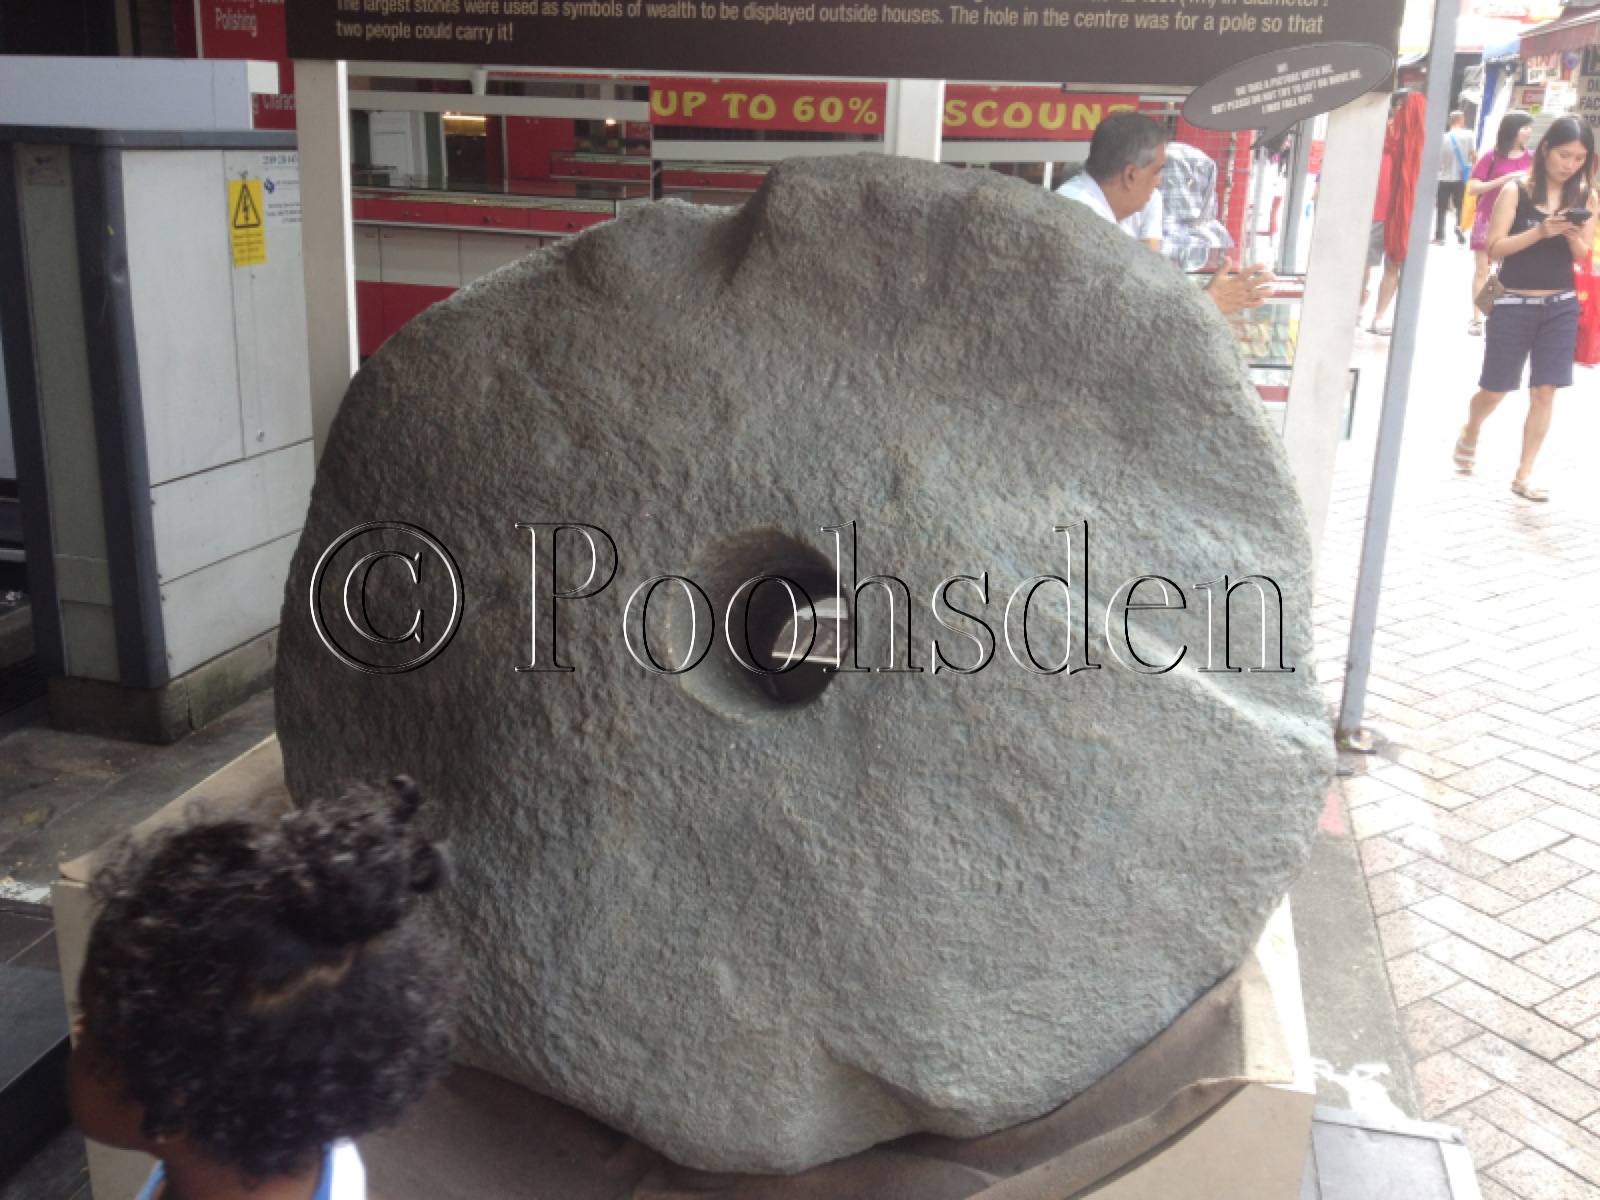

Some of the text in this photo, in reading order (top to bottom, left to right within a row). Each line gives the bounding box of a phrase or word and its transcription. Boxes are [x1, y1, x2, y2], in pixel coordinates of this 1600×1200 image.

[215, 8, 257, 37] Polishing
[336, 20, 513, 45] two people could carry it!
[414, 0, 460, 13] stones
[464, 0, 499, 14] were
[503, 0, 538, 15] used
[542, 3, 559, 16] as
[562, 1, 623, 20] symbols
[627, 1, 643, 17] of
[646, 2, 697, 18] wealth
[701, 3, 717, 20] to
[720, 2, 739, 20] be
[743, 3, 815, 25] displayed
[819, 4, 877, 22] outside
[882, 4, 944, 24] houses.
[950, 6, 979, 25] The
[984, 6, 1019, 26] hole
[1023, 7, 1039, 26] in
[1043, 8, 1069, 26] the
[1074, 10, 1129, 29] centre
[1135, 14, 1170, 30] was
[1175, 10, 1200, 30] for
[1203, 15, 1215, 31] a
[1219, 12, 1257, 35] pole
[1261, 17, 1282, 33] so
[1288, 13, 1324, 34] that
[651, 90, 707, 117] UP
[722, 93, 777, 121] TO
[793, 96, 878, 125] 60%
